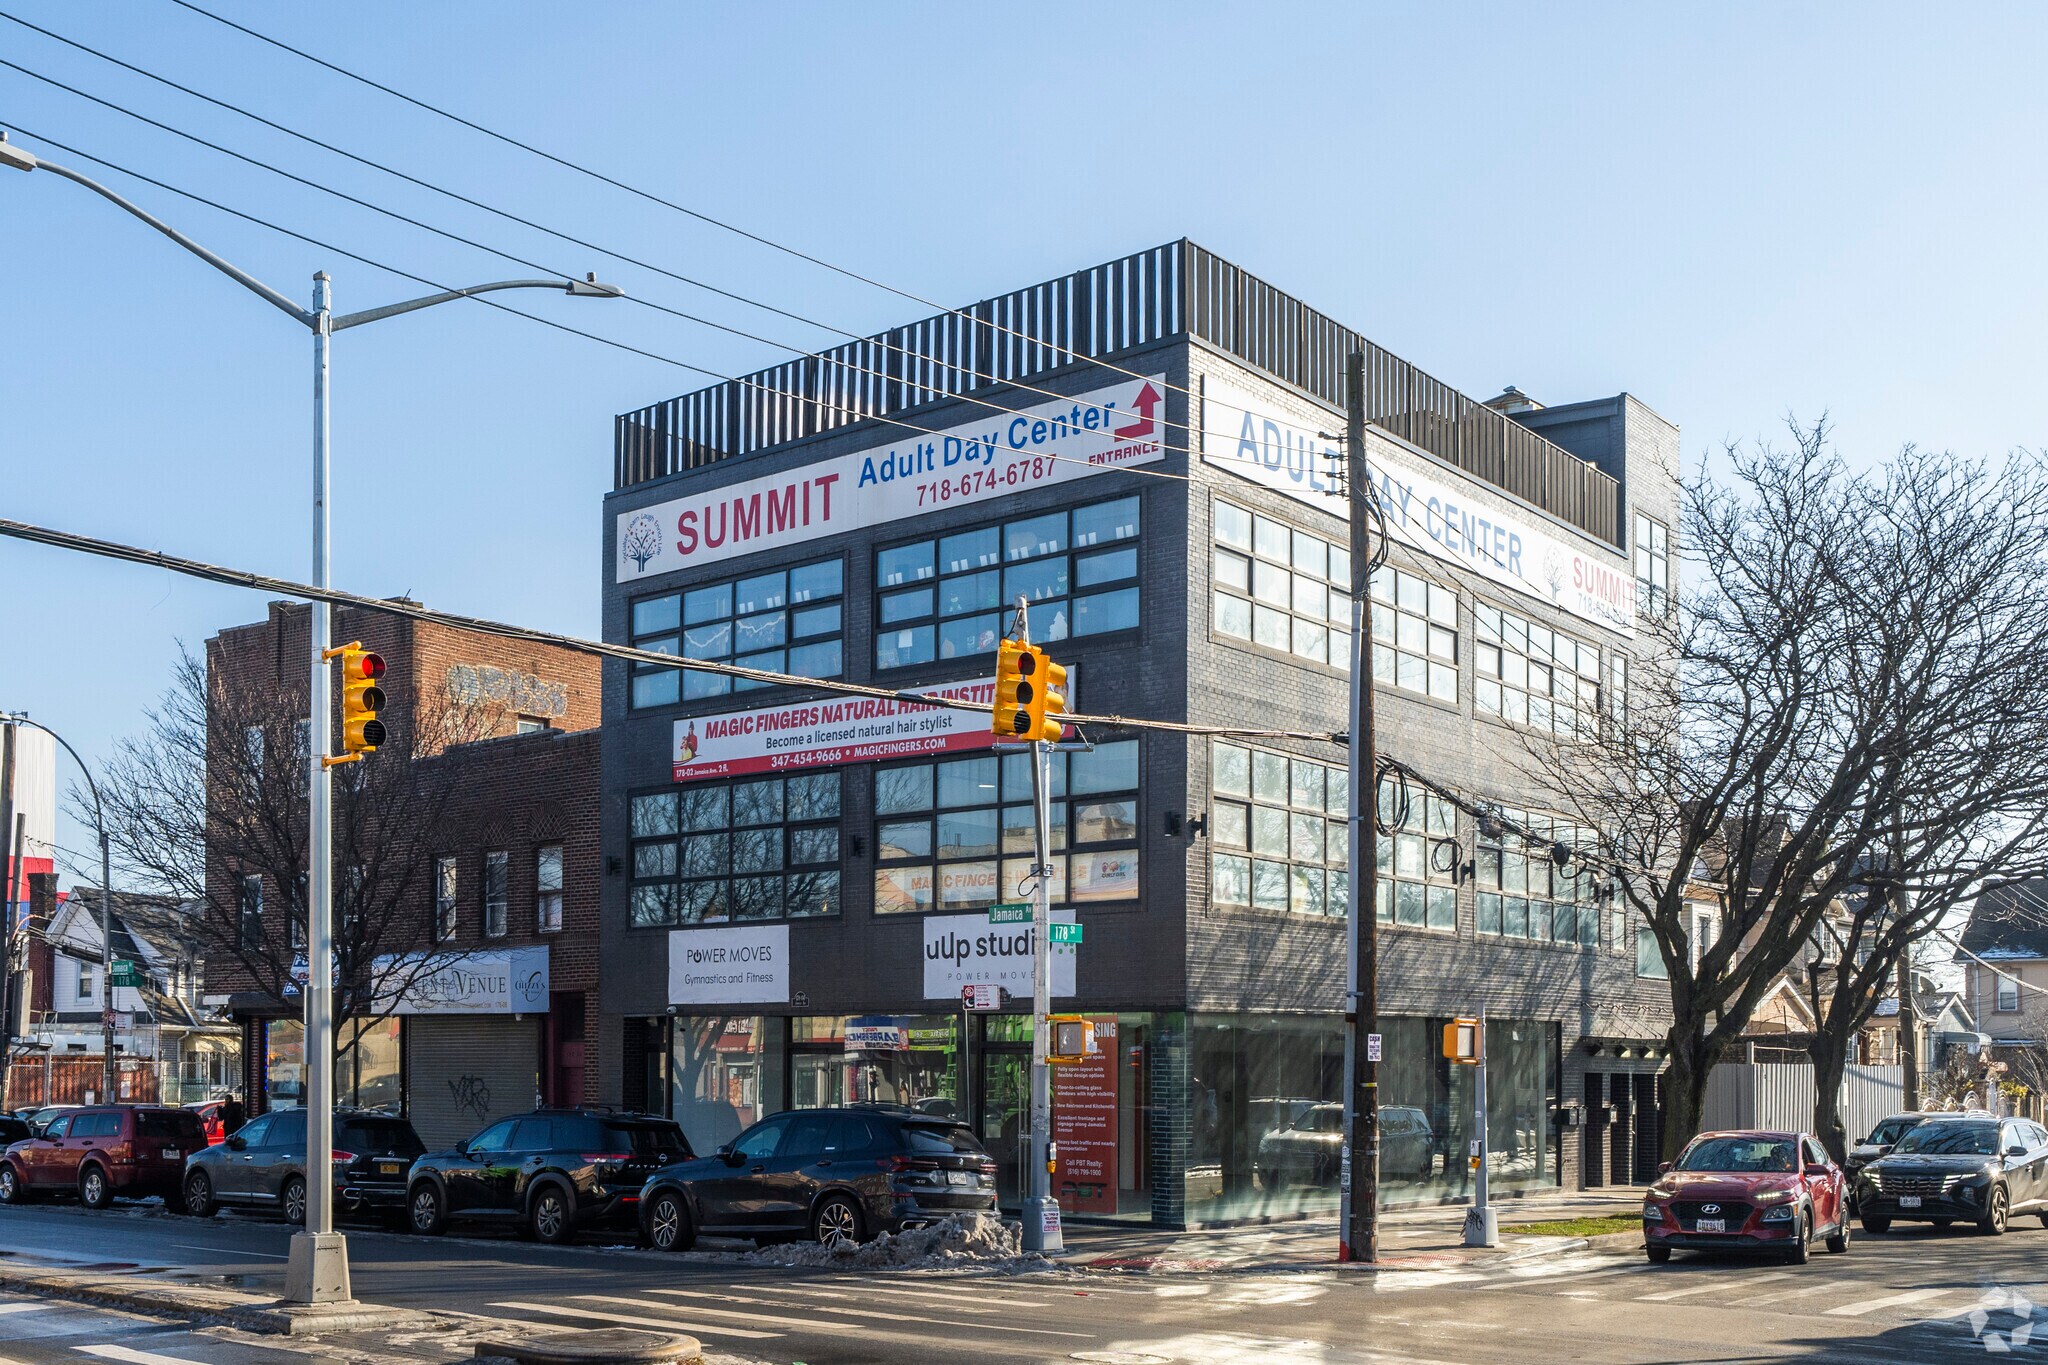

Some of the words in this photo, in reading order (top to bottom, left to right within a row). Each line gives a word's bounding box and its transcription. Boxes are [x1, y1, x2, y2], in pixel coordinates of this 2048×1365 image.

[858, 442, 934, 488] Adult
[944, 432, 999, 466] Day
[1008, 401, 1115, 449] Center
[1088, 441, 1159, 467] ENTRANCE
[917, 453, 1057, 506] 718-674-6787
[1237, 411, 1341, 497] ADULT
[1366, 466, 1412, 528] AY
[1427, 497, 1522, 577] CENTER
[677, 473, 839, 555] SUMMIT
[1573, 557, 1635, 611] SUMMIT
[705, 716, 754, 739] MAGIC
[756, 707, 818, 733] FINGERS
[821, 697, 895, 725] NATURAL
[940, 683, 995, 709] INSTIT
[766, 735, 804, 749] Become
[806, 734, 812, 744] a
[815, 726, 856, 743] licensed
[858, 720, 894, 737] natural
[897, 719, 917, 733] hair
[920, 715, 952, 733] stylist
[771, 749, 842, 768] 347-454-9666
[854, 738, 946, 758] MAGICFINGERS.COM
[676, 768, 694, 778] 178-02
[718, 764, 723, 773] 2
[991, 907, 1023, 922] Jamaica
[976, 927, 1052, 957] studi
[1055, 926, 1068, 940] 178
[687, 948, 726, 964] POWER
[729, 945, 772, 962] MOVES
[118, 976, 130, 986] 178
[452, 971, 506, 995] VENUE
[684, 973, 727, 987] Gymnastics
[728, 972, 743, 984] and
[746, 971, 774, 983] Fitness
[947, 972, 990, 980] POWER
[1000, 971, 1035, 980] MOVE
[1094, 1022, 1116, 1038] SING
[1067, 1168, 1079, 1176] (516)
[1086, 1160, 1103, 1168] Realty:
